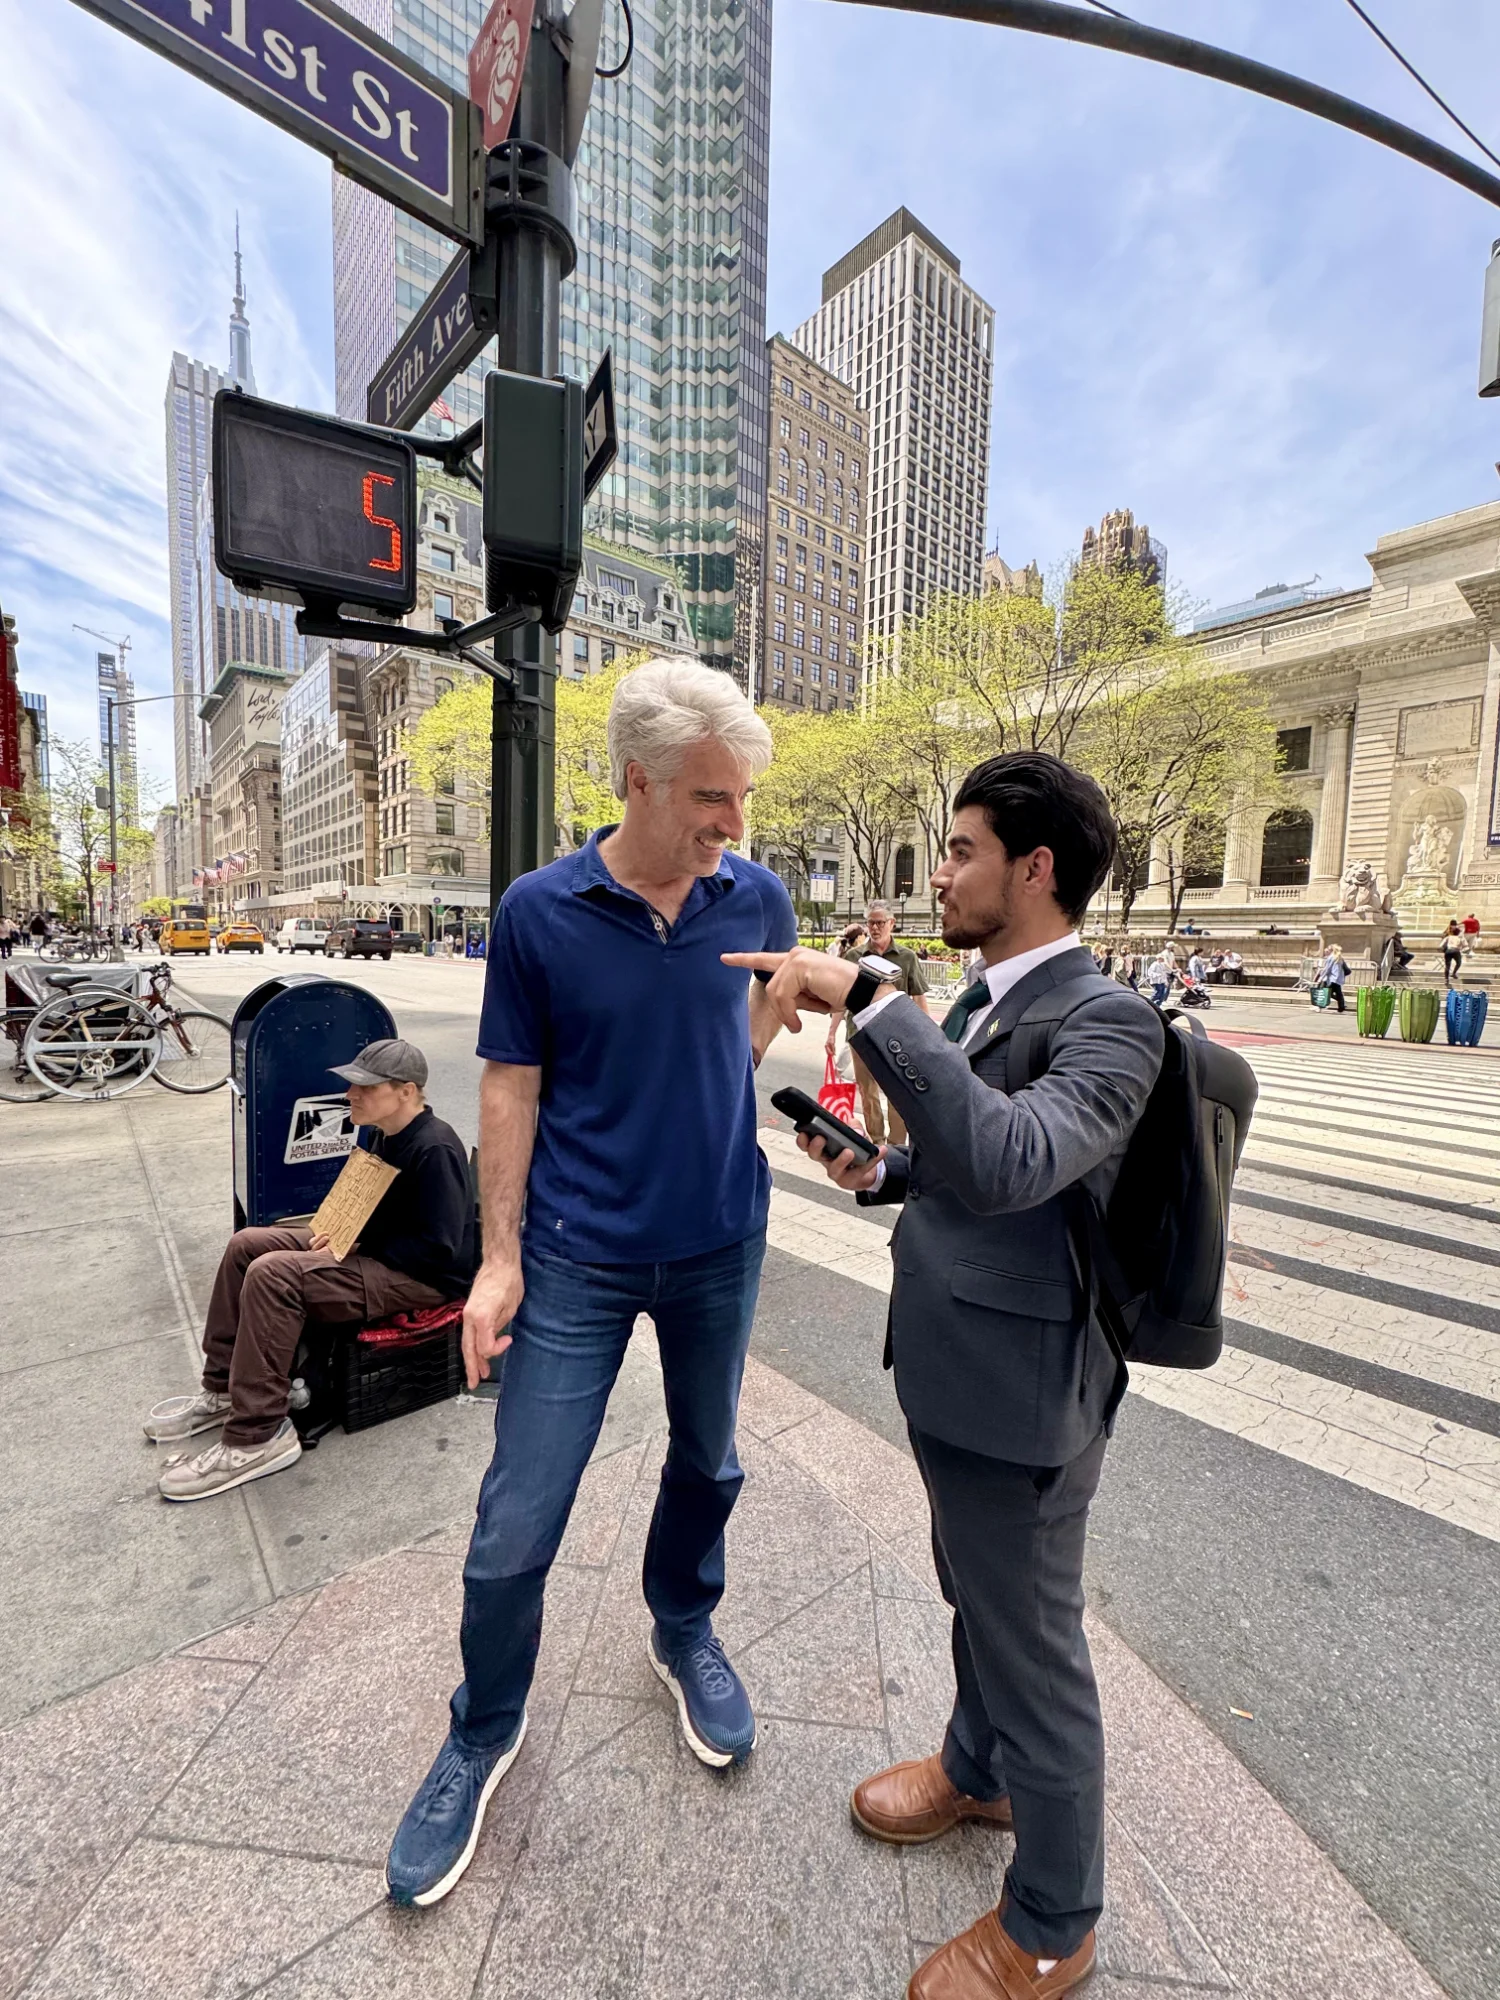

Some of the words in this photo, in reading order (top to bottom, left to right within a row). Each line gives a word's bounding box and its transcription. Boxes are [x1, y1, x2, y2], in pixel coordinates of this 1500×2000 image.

[352, 70, 419, 162] St
[385, 344, 424, 423] Fifth
[429, 292, 467, 364] Ave
[363, 471, 401, 571] 5
[289, 1150, 319, 1160] POSTAL
[321, 1144, 351, 1155] SERVICE
[291, 1142, 322, 1153] UNITED
